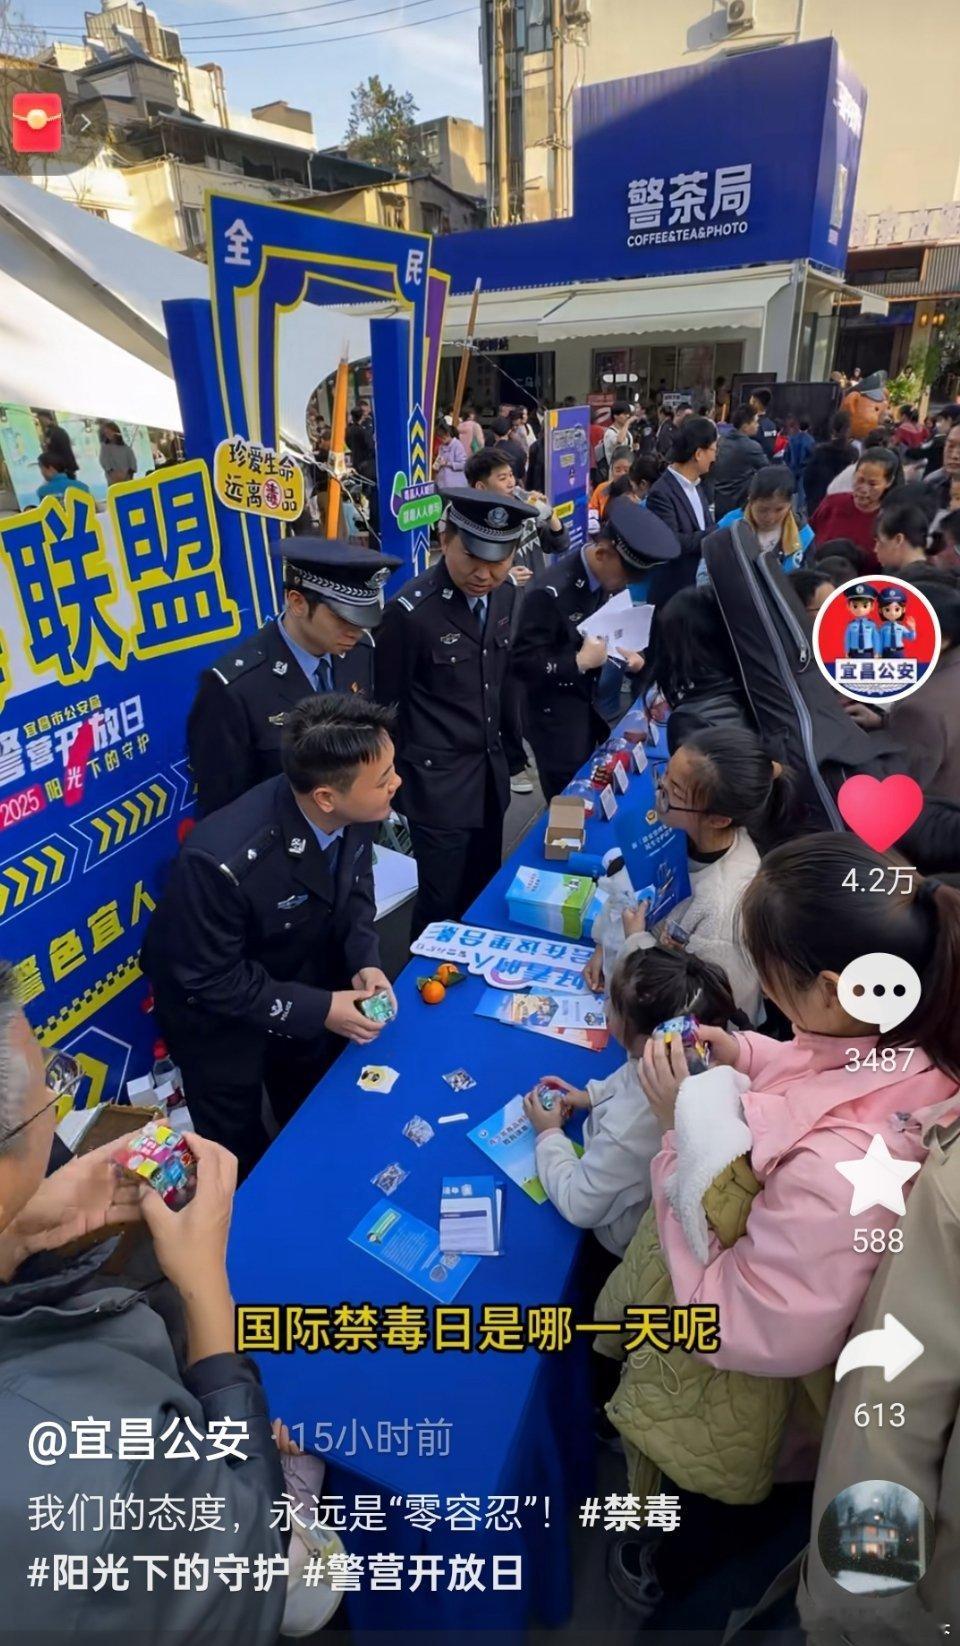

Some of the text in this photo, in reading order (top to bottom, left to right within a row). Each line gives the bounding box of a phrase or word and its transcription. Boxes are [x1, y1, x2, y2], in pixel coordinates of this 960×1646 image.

[627, 163, 752, 230] 警茶局
[225, 218, 424, 286] 全 民
[627, 221, 748, 247] COFFEE&TEA&PHOTO
[228, 440, 295, 481] 珍爱生命
[225, 473, 297, 511] 远离毒品
[0, 470, 235, 682] 联盟
[23, 694, 102, 739] 宜昌市公安局
[0, 733, 150, 828] 2025 阳光下的守护
